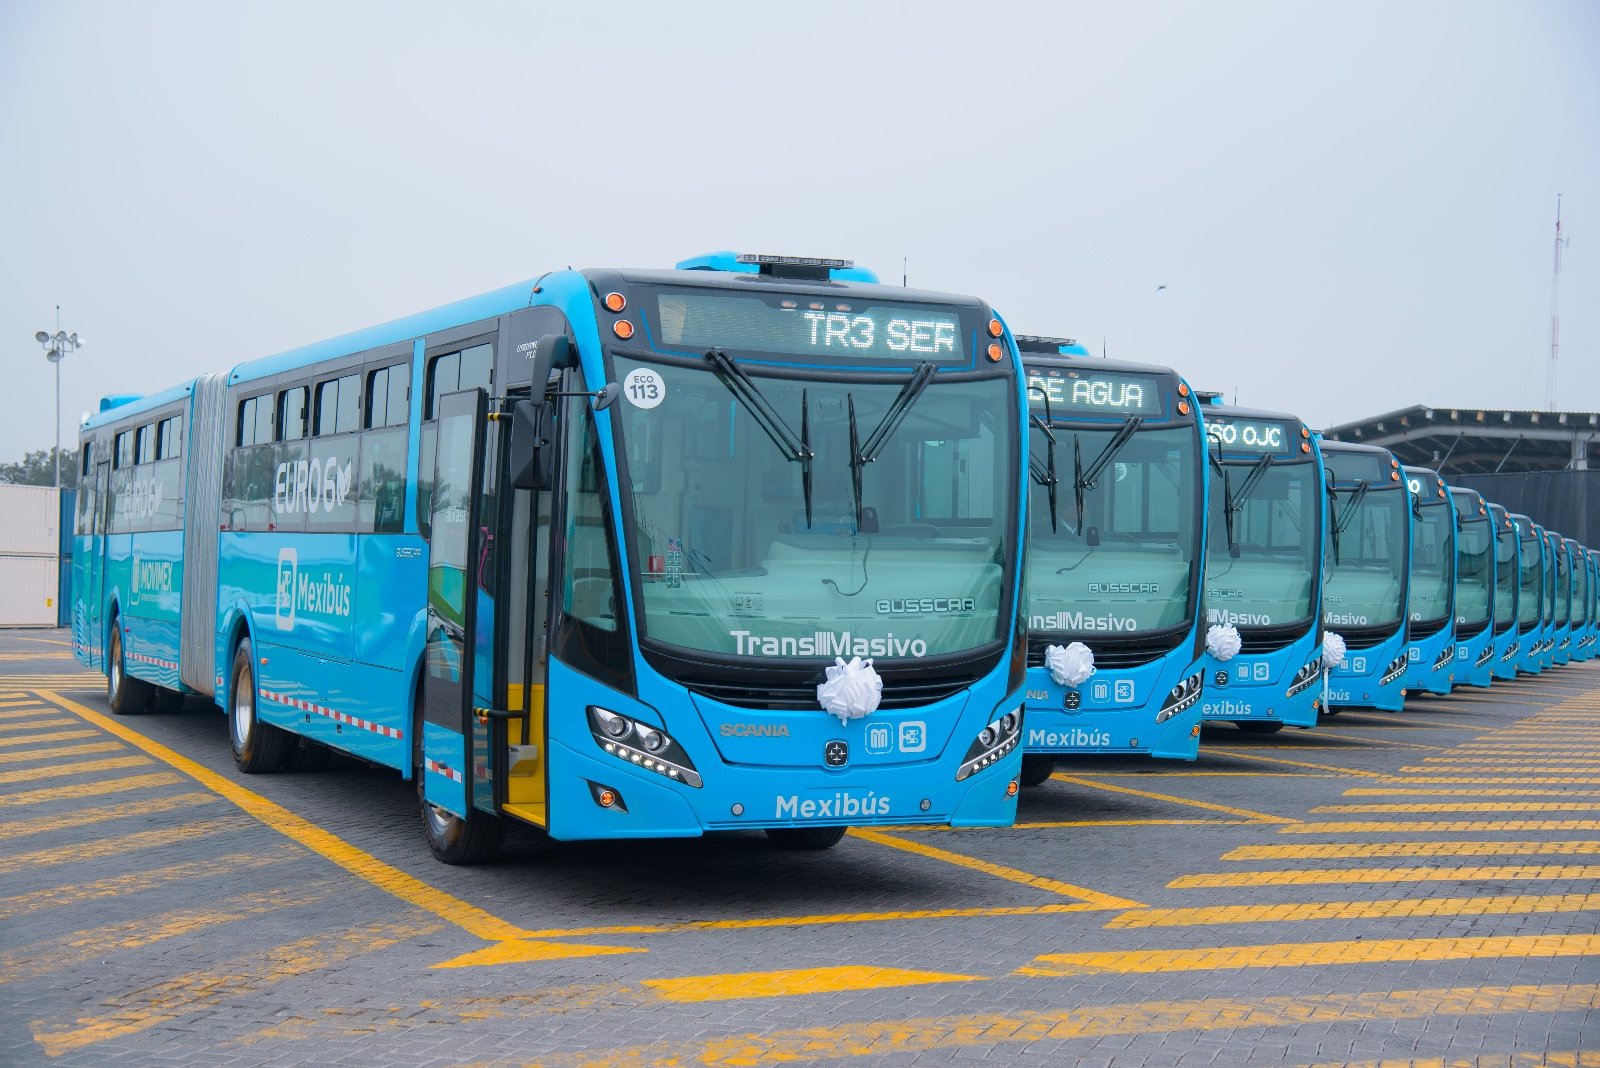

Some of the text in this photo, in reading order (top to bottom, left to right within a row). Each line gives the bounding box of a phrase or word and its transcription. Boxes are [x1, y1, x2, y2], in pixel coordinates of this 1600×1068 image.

[804, 312, 875, 348] TR3
[634, 375, 654, 383] ECO
[630, 384, 659, 399] 113
[1028, 376, 1143, 408] DE AGUA
[141, 562, 173, 592] MOVIMEX
[297, 572, 351, 617] Mexibús
[1087, 582, 1160, 594] BUSSCAR
[875, 597, 976, 614] BUSSCAR
[719, 723, 790, 737] SCANIA
[1028, 728, 1111, 746] Mexibús
[775, 790, 890, 819] Mexibús
